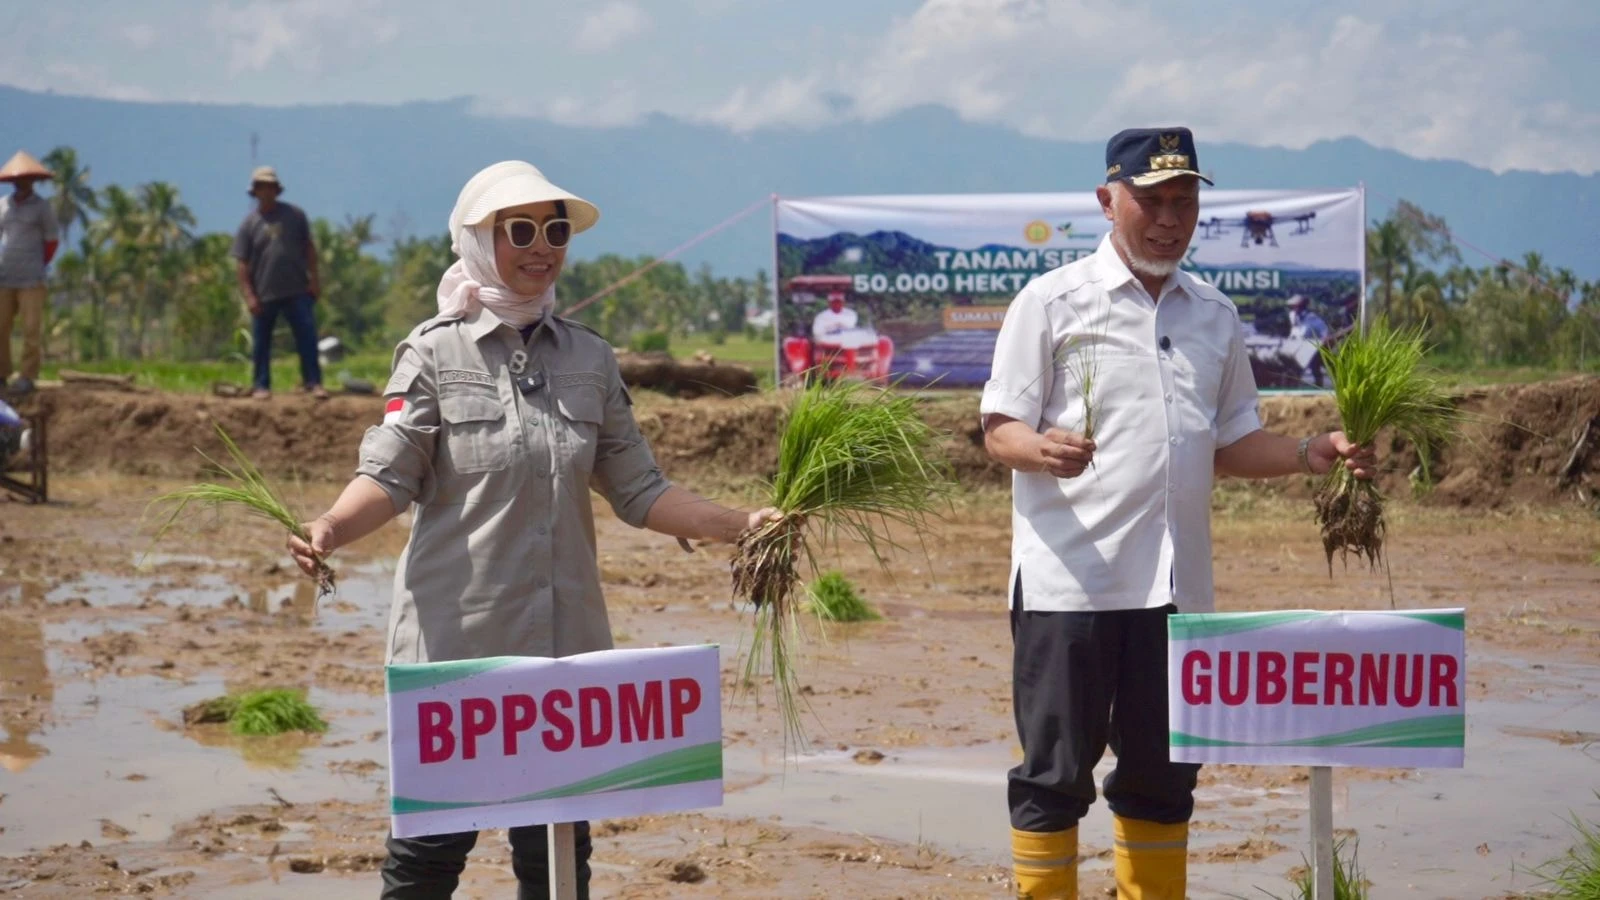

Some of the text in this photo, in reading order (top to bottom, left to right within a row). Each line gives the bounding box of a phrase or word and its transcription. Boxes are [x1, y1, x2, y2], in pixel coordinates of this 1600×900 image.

[935, 251, 1037, 270] TANAM
[854, 273, 949, 293] 50.000
[1195, 270, 1280, 290] VINSI
[1181, 649, 1459, 707] GUBERNUR
[417, 677, 702, 764] BPPSDMP
